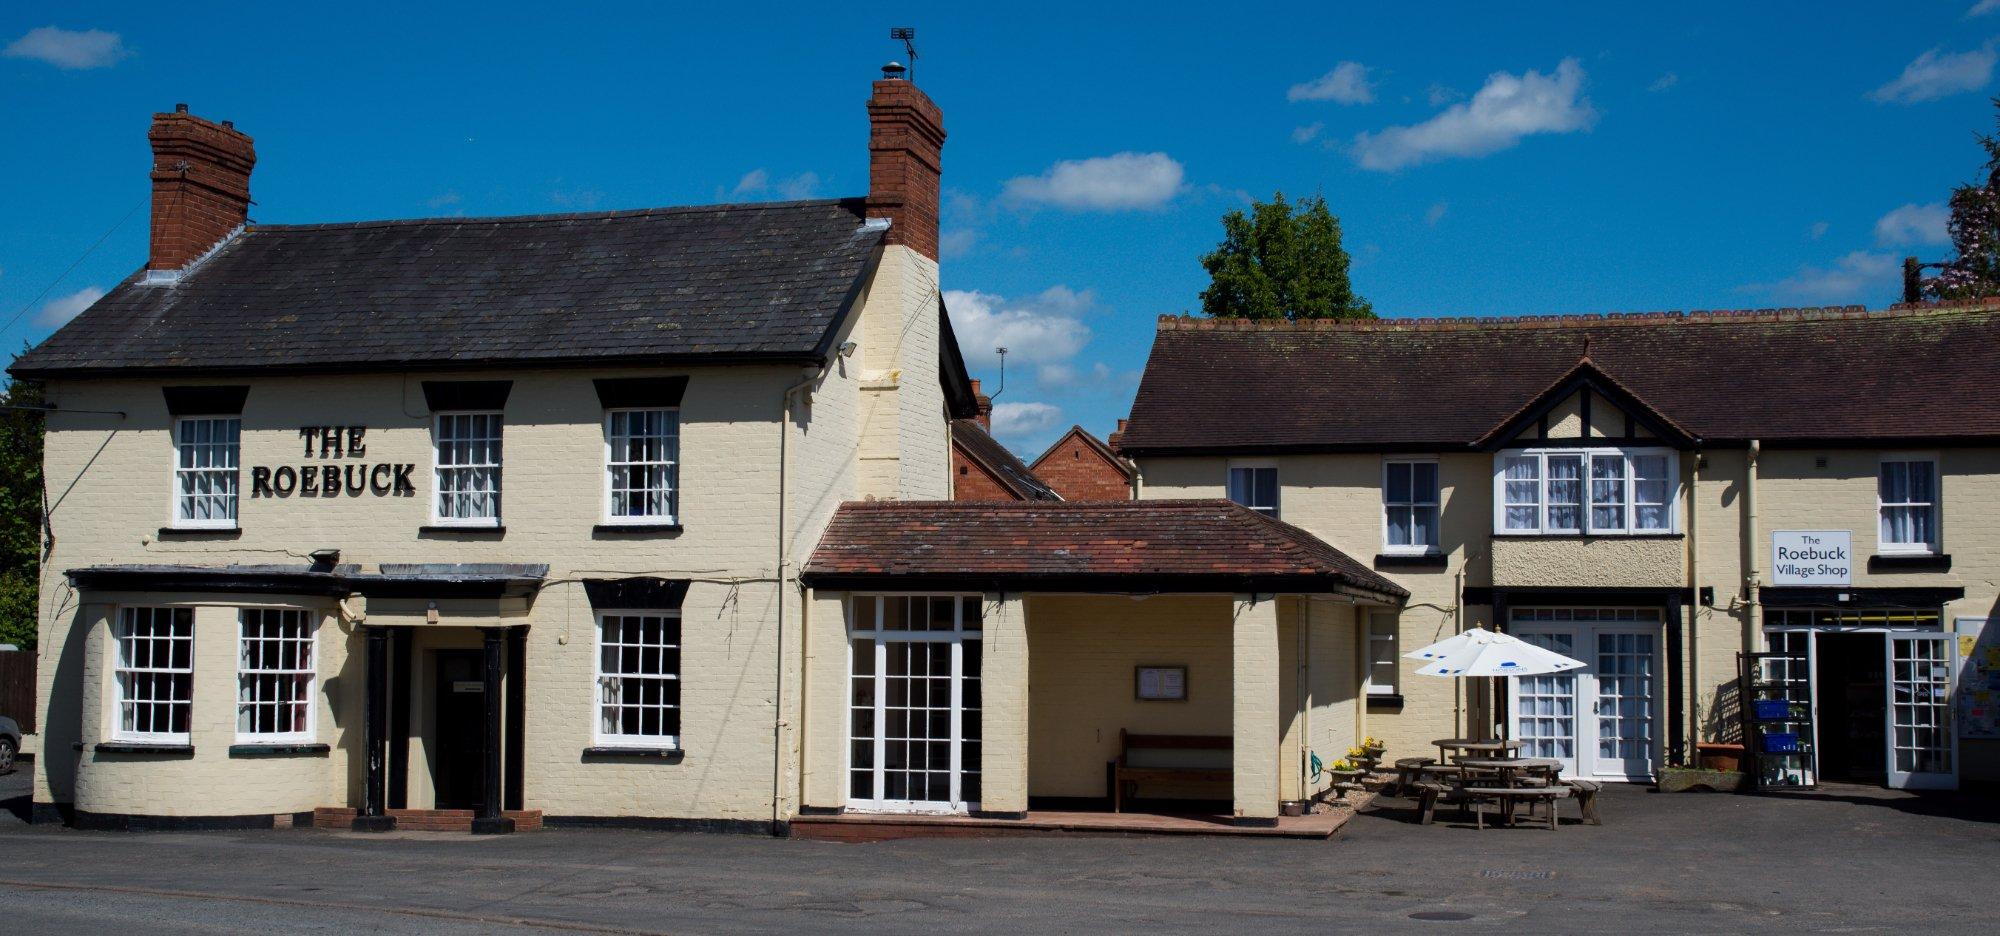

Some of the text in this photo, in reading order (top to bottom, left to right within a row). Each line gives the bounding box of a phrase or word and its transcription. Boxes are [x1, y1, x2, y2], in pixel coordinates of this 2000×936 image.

[300, 426, 367, 454] THE
[252, 463, 416, 495] ROEBUCK
[1801, 535, 1820, 545] The
[1778, 546, 1846, 560] Roebuck
[1776, 564, 1848, 578] Village Shop
